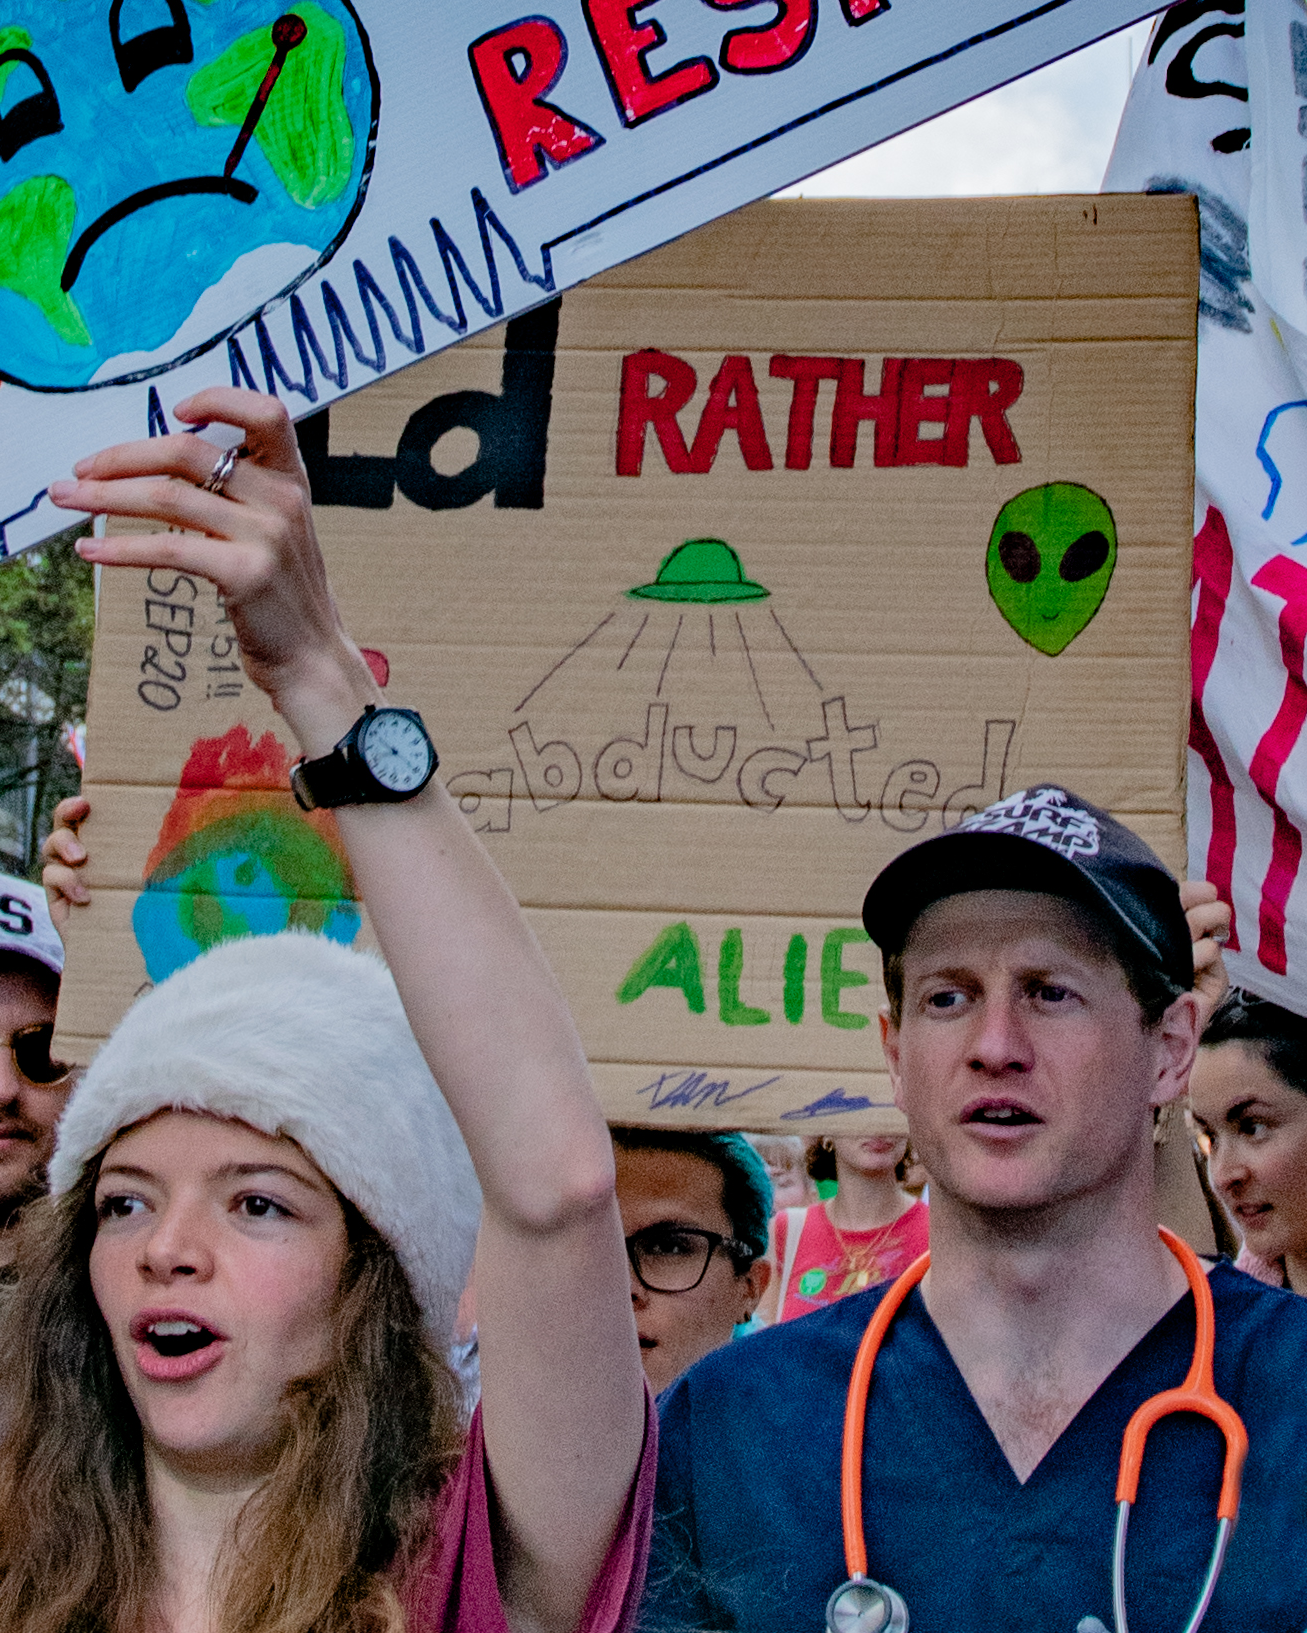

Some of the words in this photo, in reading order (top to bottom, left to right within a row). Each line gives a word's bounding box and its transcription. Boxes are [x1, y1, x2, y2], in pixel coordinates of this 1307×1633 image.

[615, 347, 1025, 478] RATHER
[446, 696, 1016, 833] abducted
[615, 920, 872, 1030] ALIE
